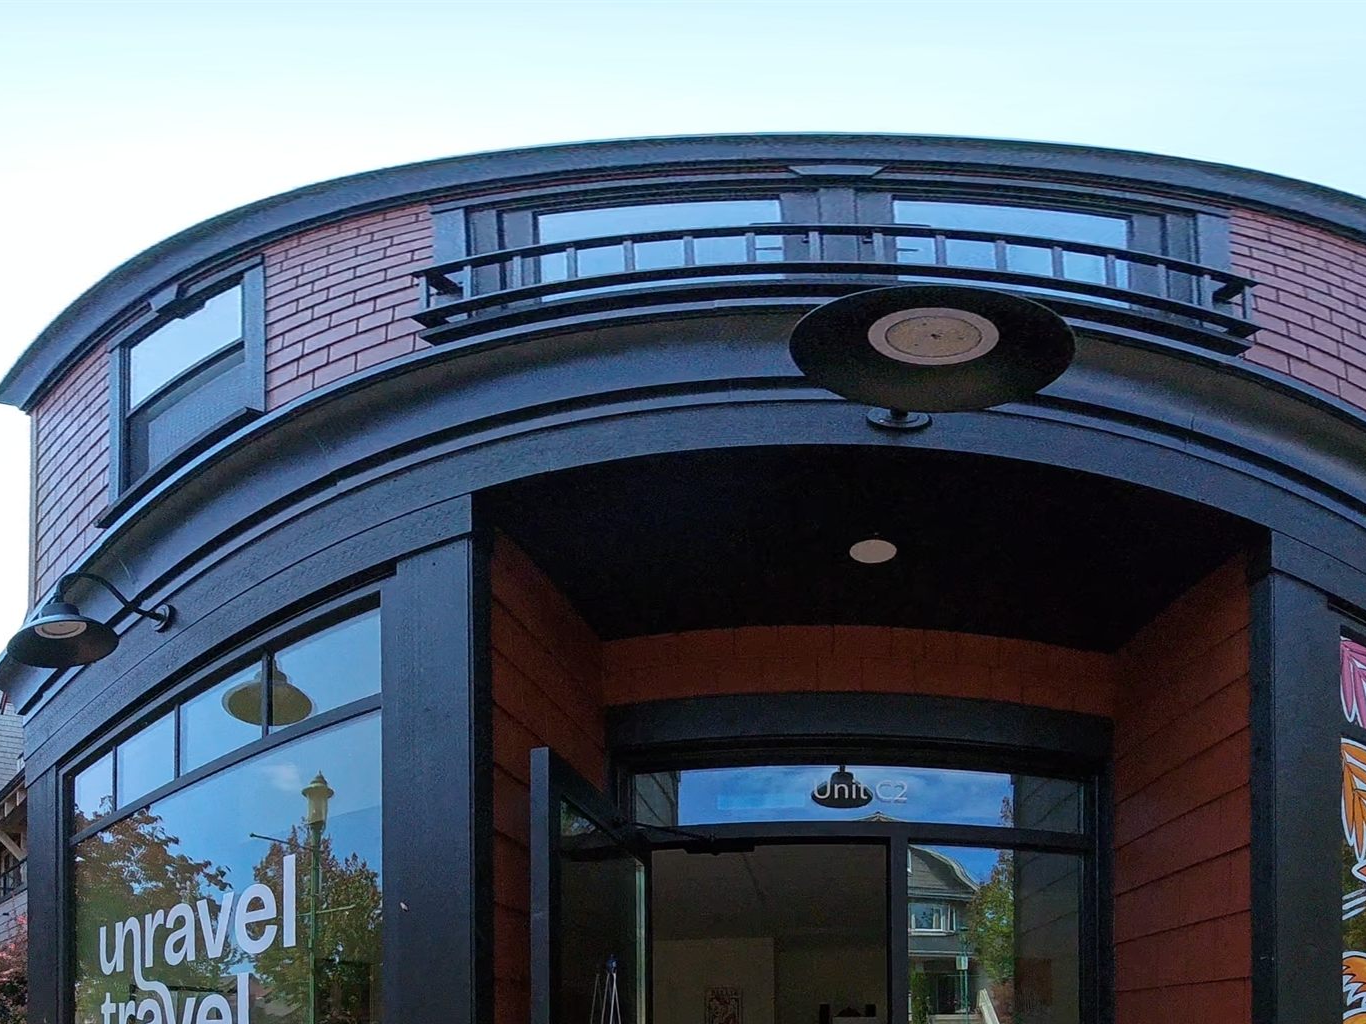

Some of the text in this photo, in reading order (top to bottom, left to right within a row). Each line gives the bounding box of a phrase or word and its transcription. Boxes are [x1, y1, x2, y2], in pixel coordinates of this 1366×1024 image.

[814, 778, 908, 801] Unit C2
[99, 853, 297, 980] unravel
